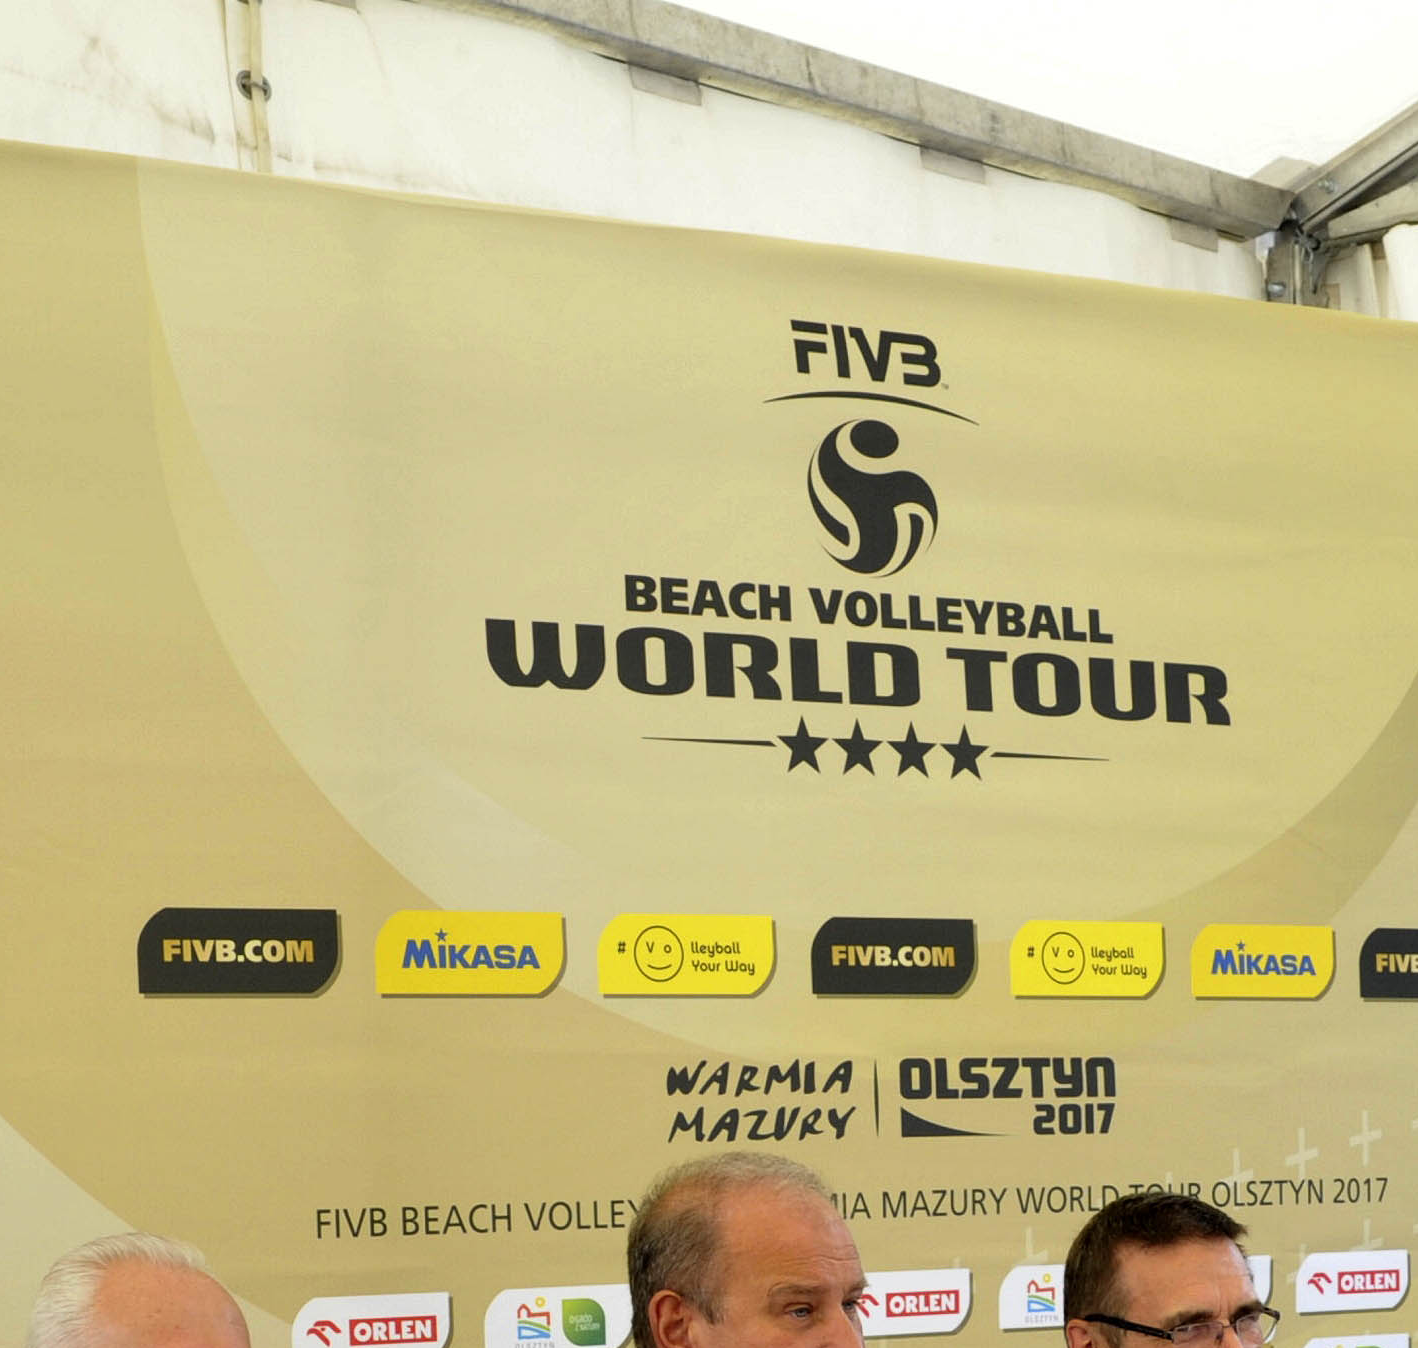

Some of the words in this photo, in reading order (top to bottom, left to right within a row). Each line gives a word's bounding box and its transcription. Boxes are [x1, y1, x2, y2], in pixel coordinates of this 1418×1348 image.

[790, 320, 941, 387] FIVB
[624, 574, 792, 623] BEACH
[808, 587, 1114, 644] VOLLEYBALL
[485, 618, 921, 706] WORLD
[947, 647, 1231, 726] TOUR
[163, 940, 314, 963] FIVB.COM
[831, 946, 955, 967] FIVB.COM
[692, 960, 720, 972] Your
[725, 960, 755, 975] Way
[1091, 964, 1120, 977] Your
[1123, 964, 1147, 979] Way
[666, 1058, 852, 1097] WARMIA
[899, 1057, 1116, 1099] OLSZTYN
[668, 1105, 856, 1143] MAZURY
[1034, 1104, 1115, 1135] 2017
[316, 1207, 387, 1239] FIVB
[402, 1202, 512, 1236] BEACH
[883, 1188, 1007, 1219] MAZURY
[1212, 1178, 1326, 1208] OLSZTYN
[1333, 1177, 1388, 1205] 2017
[1341, 1274, 1397, 1291] ORLEN
[889, 1294, 956, 1314] ORLEN
[354, 1320, 432, 1343] ORLEN
